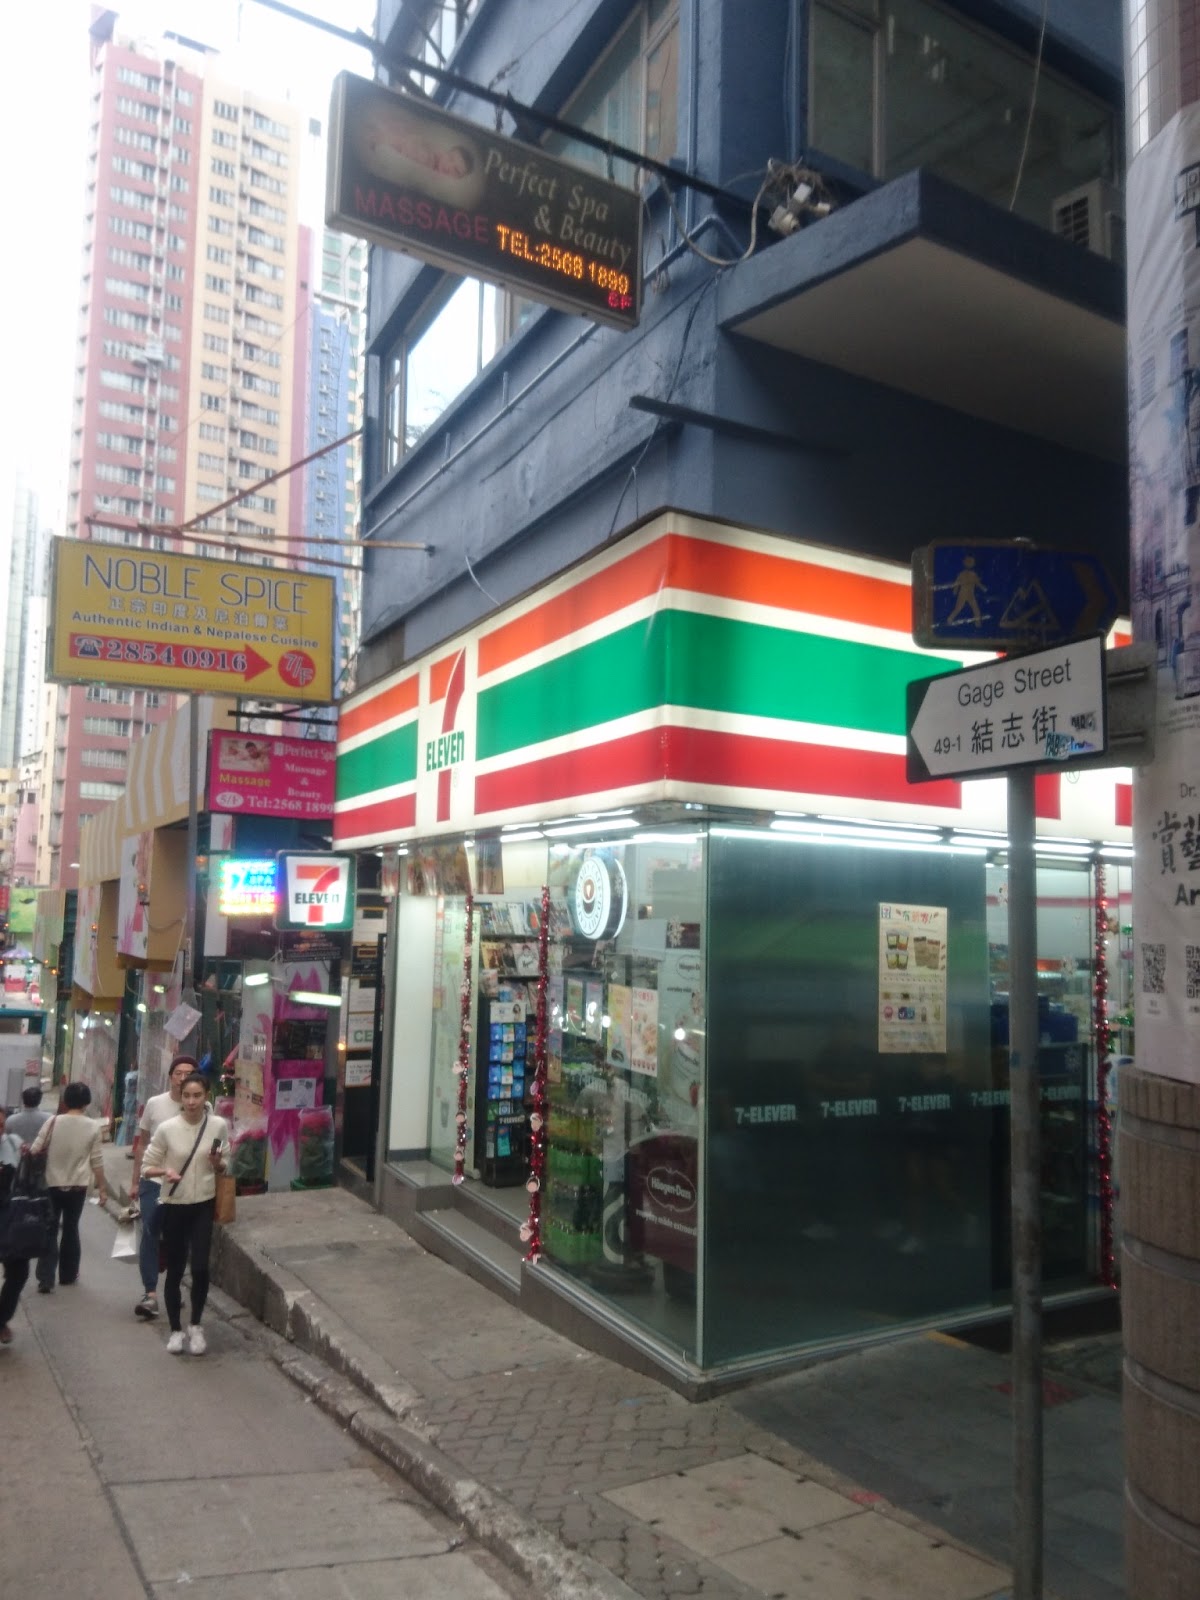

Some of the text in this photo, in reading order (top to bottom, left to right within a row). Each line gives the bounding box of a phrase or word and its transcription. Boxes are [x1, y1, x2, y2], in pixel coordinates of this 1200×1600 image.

[484, 149, 608, 223] Perfect Spa
[355, 187, 489, 242] MASSAGE
[534, 206, 632, 269] & Beauty
[84, 554, 308, 614] NOBLE SPICE
[72, 611, 319, 649] Authentic Indian & Nepalese Cuisine
[106, 640, 247, 672] 2854 0916
[284, 653, 313, 685] 7/F
[958, 658, 1072, 708] Gage Street
[934, 735, 962, 755] 49-1
[971, 706, 1058, 755] 結志街
[219, 773, 271, 788] Massage
[284, 763, 328, 777] Massage
[300, 777, 309, 786] &
[248, 795, 302, 811] Tel:2568
[287, 787, 321, 800] Beauty
